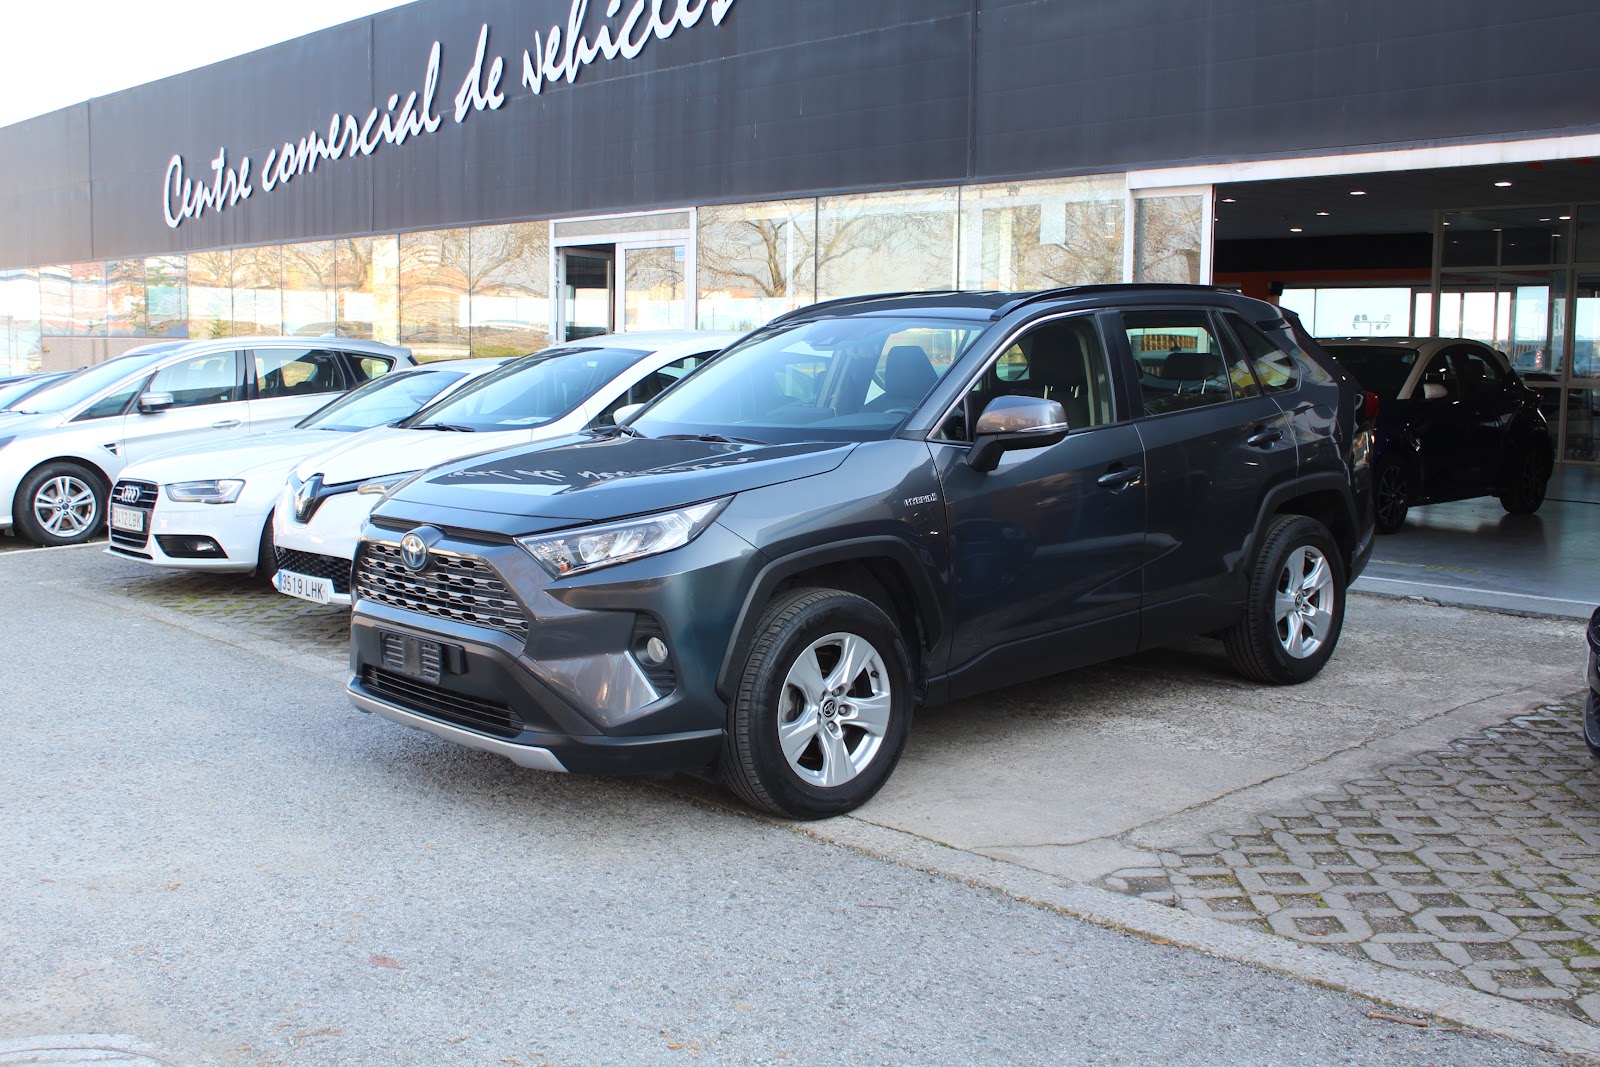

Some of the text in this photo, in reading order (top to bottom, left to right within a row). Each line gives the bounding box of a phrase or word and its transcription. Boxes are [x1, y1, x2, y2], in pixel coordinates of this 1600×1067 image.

[163, 146, 252, 229] Centre
[261, 40, 441, 192] comercial
[454, 23, 505, 124] de
[282, 574, 324, 600] 3519 LHK
